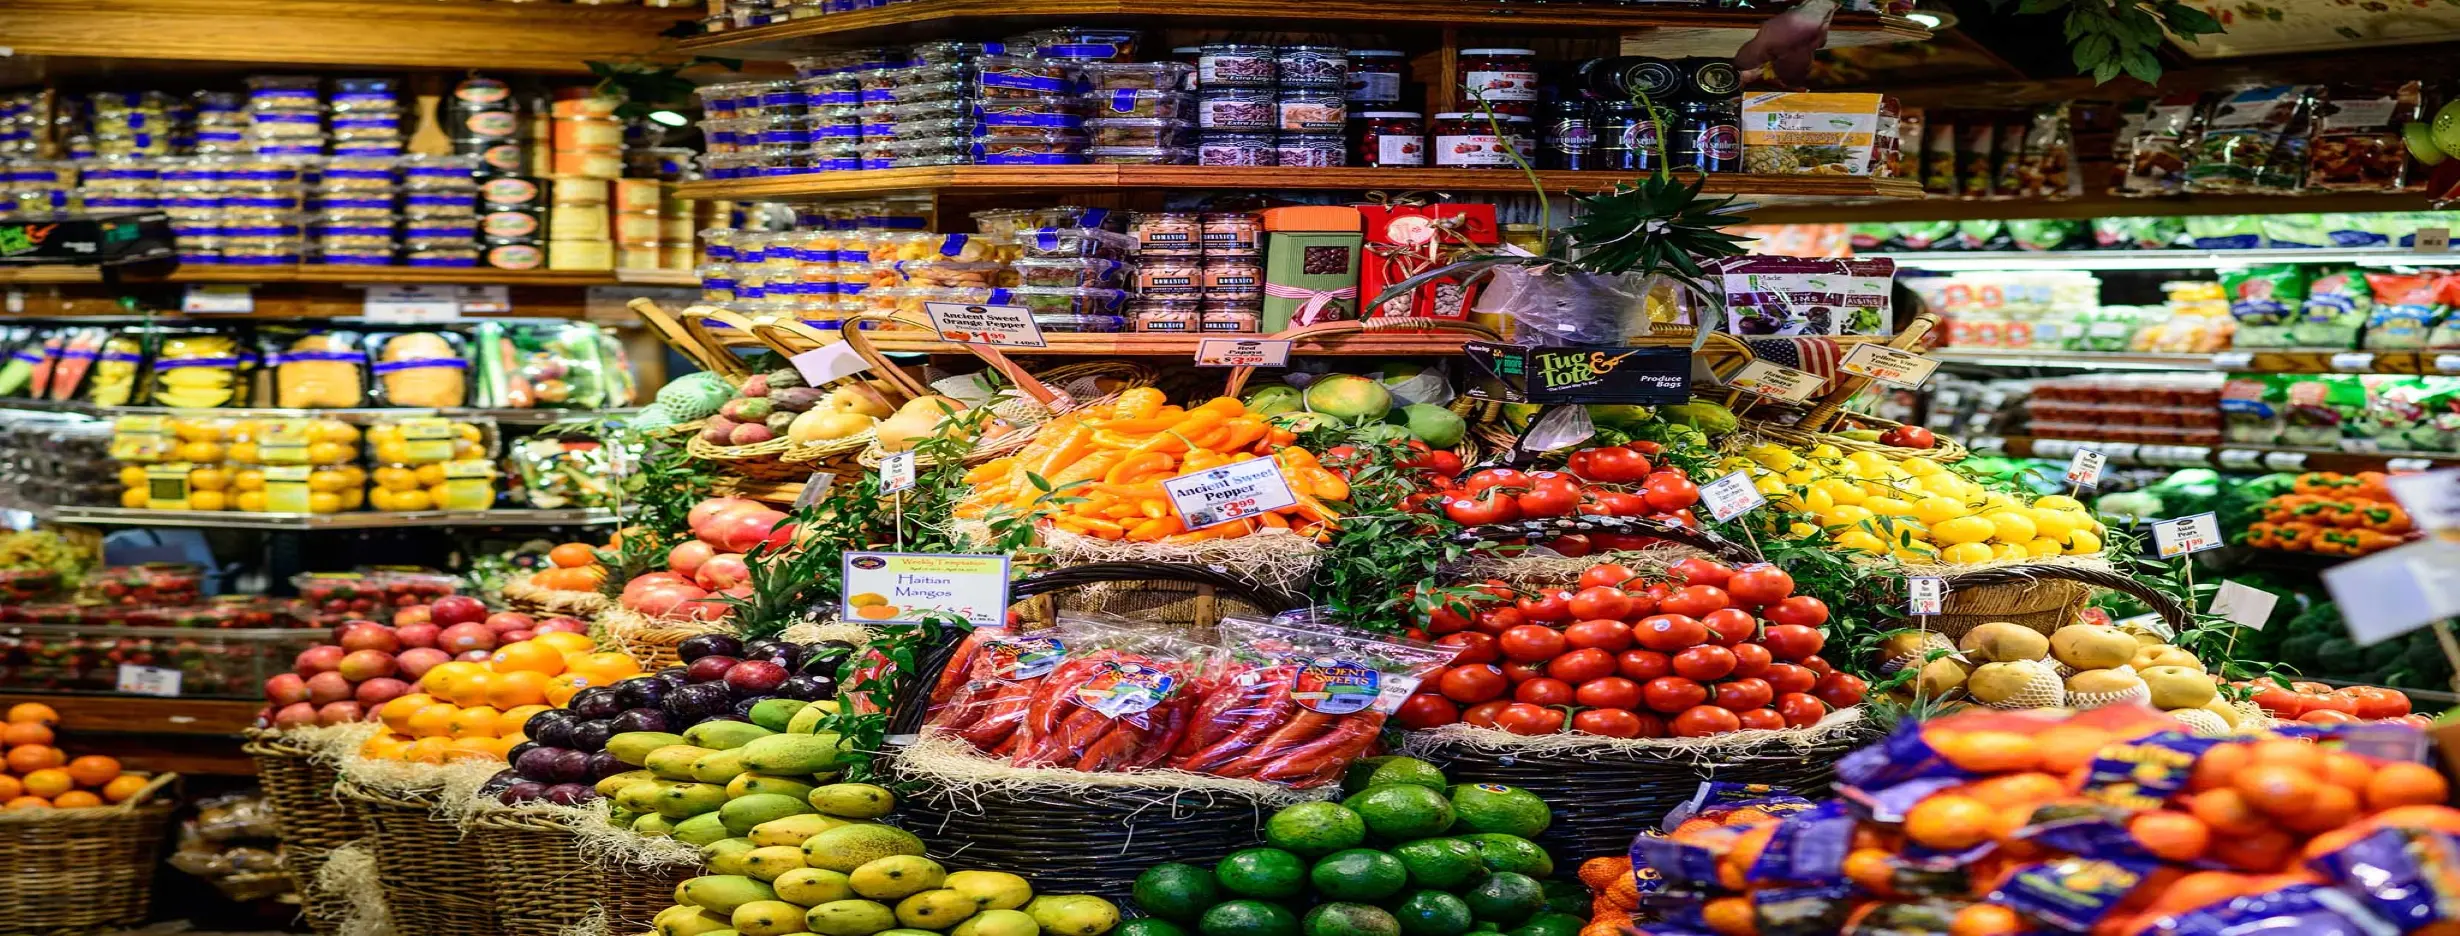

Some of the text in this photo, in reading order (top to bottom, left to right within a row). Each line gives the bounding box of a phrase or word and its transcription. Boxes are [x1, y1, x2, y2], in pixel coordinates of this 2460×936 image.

[943, 312, 984, 320] Ancient
[942, 318, 1026, 329] Orange Pepper
[1536, 352, 1586, 370] Tug
[1871, 358, 1910, 370] Tomatoes
[1537, 365, 1596, 388] Tote
[1177, 468, 1274, 498] Ancient Sweet
[1204, 484, 1256, 501] Pepper
[1243, 506, 1260, 514] Bag
[901, 558, 986, 567] Weekly Temptation
[898, 574, 950, 584] Haitian
[895, 587, 952, 600] Mangos
[1303, 666, 1366, 677] ANCIENT
[1315, 674, 1369, 685] SWEETS
